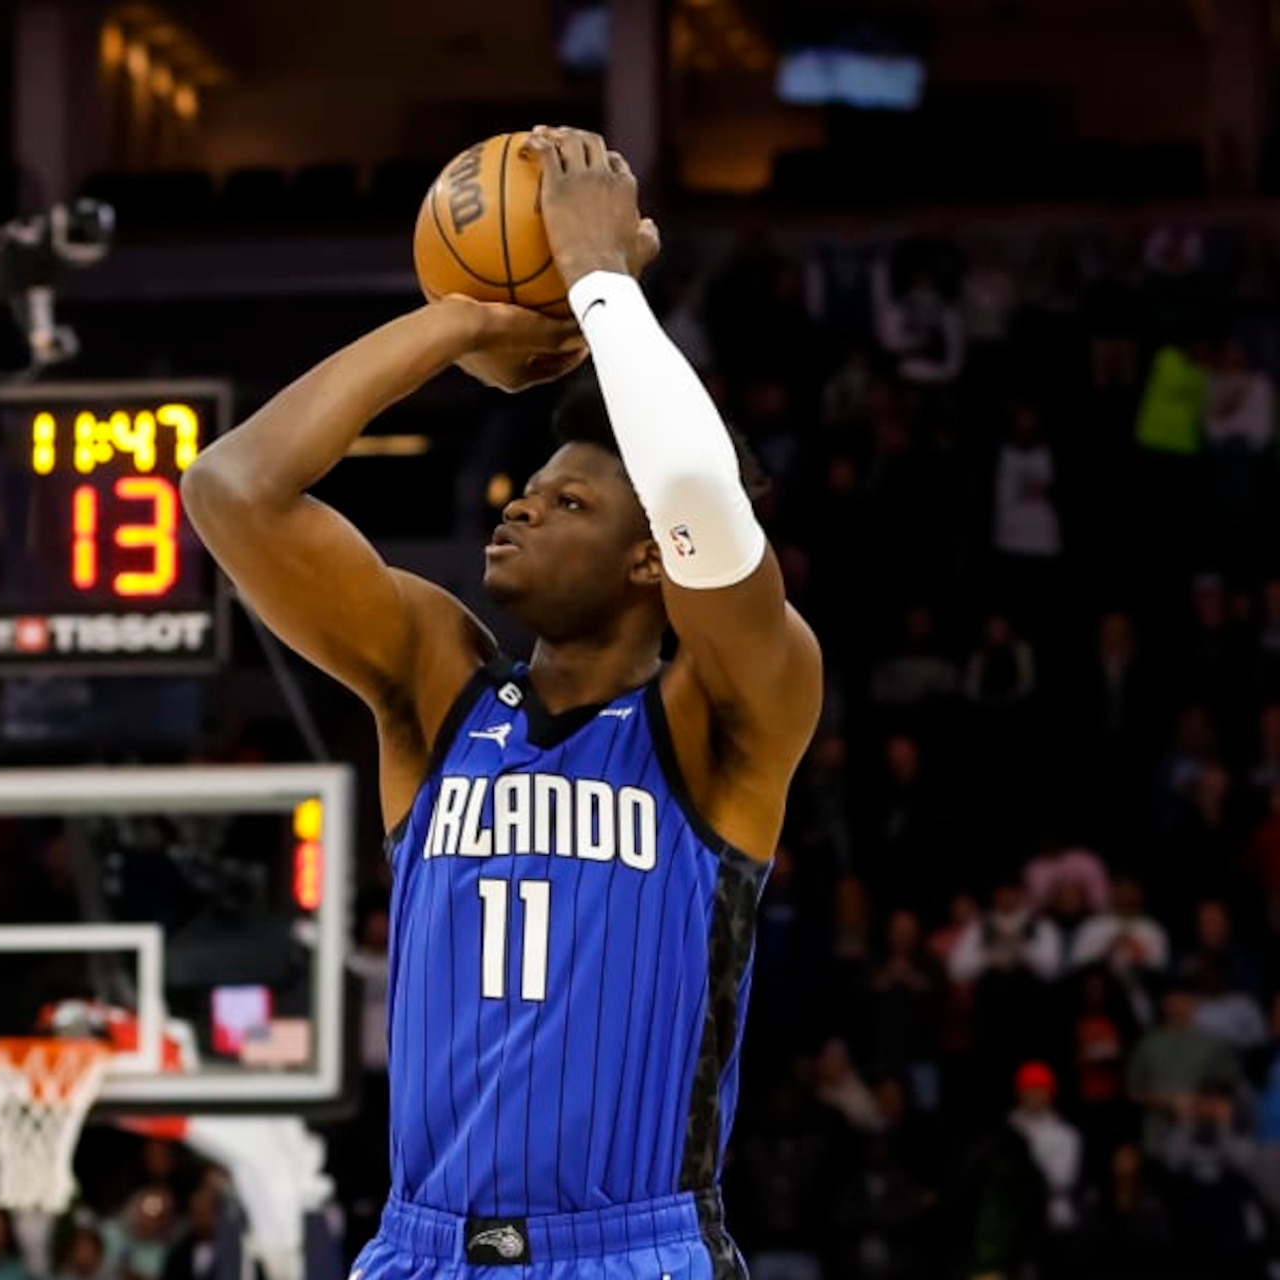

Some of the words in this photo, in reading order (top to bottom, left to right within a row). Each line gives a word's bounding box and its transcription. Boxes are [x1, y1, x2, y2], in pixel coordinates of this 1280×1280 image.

[32, 404, 199, 475] 11:47
[72, 477, 178, 597] 13
[422, 771, 658, 872] RLANDO
[477, 878, 551, 1001] 11
